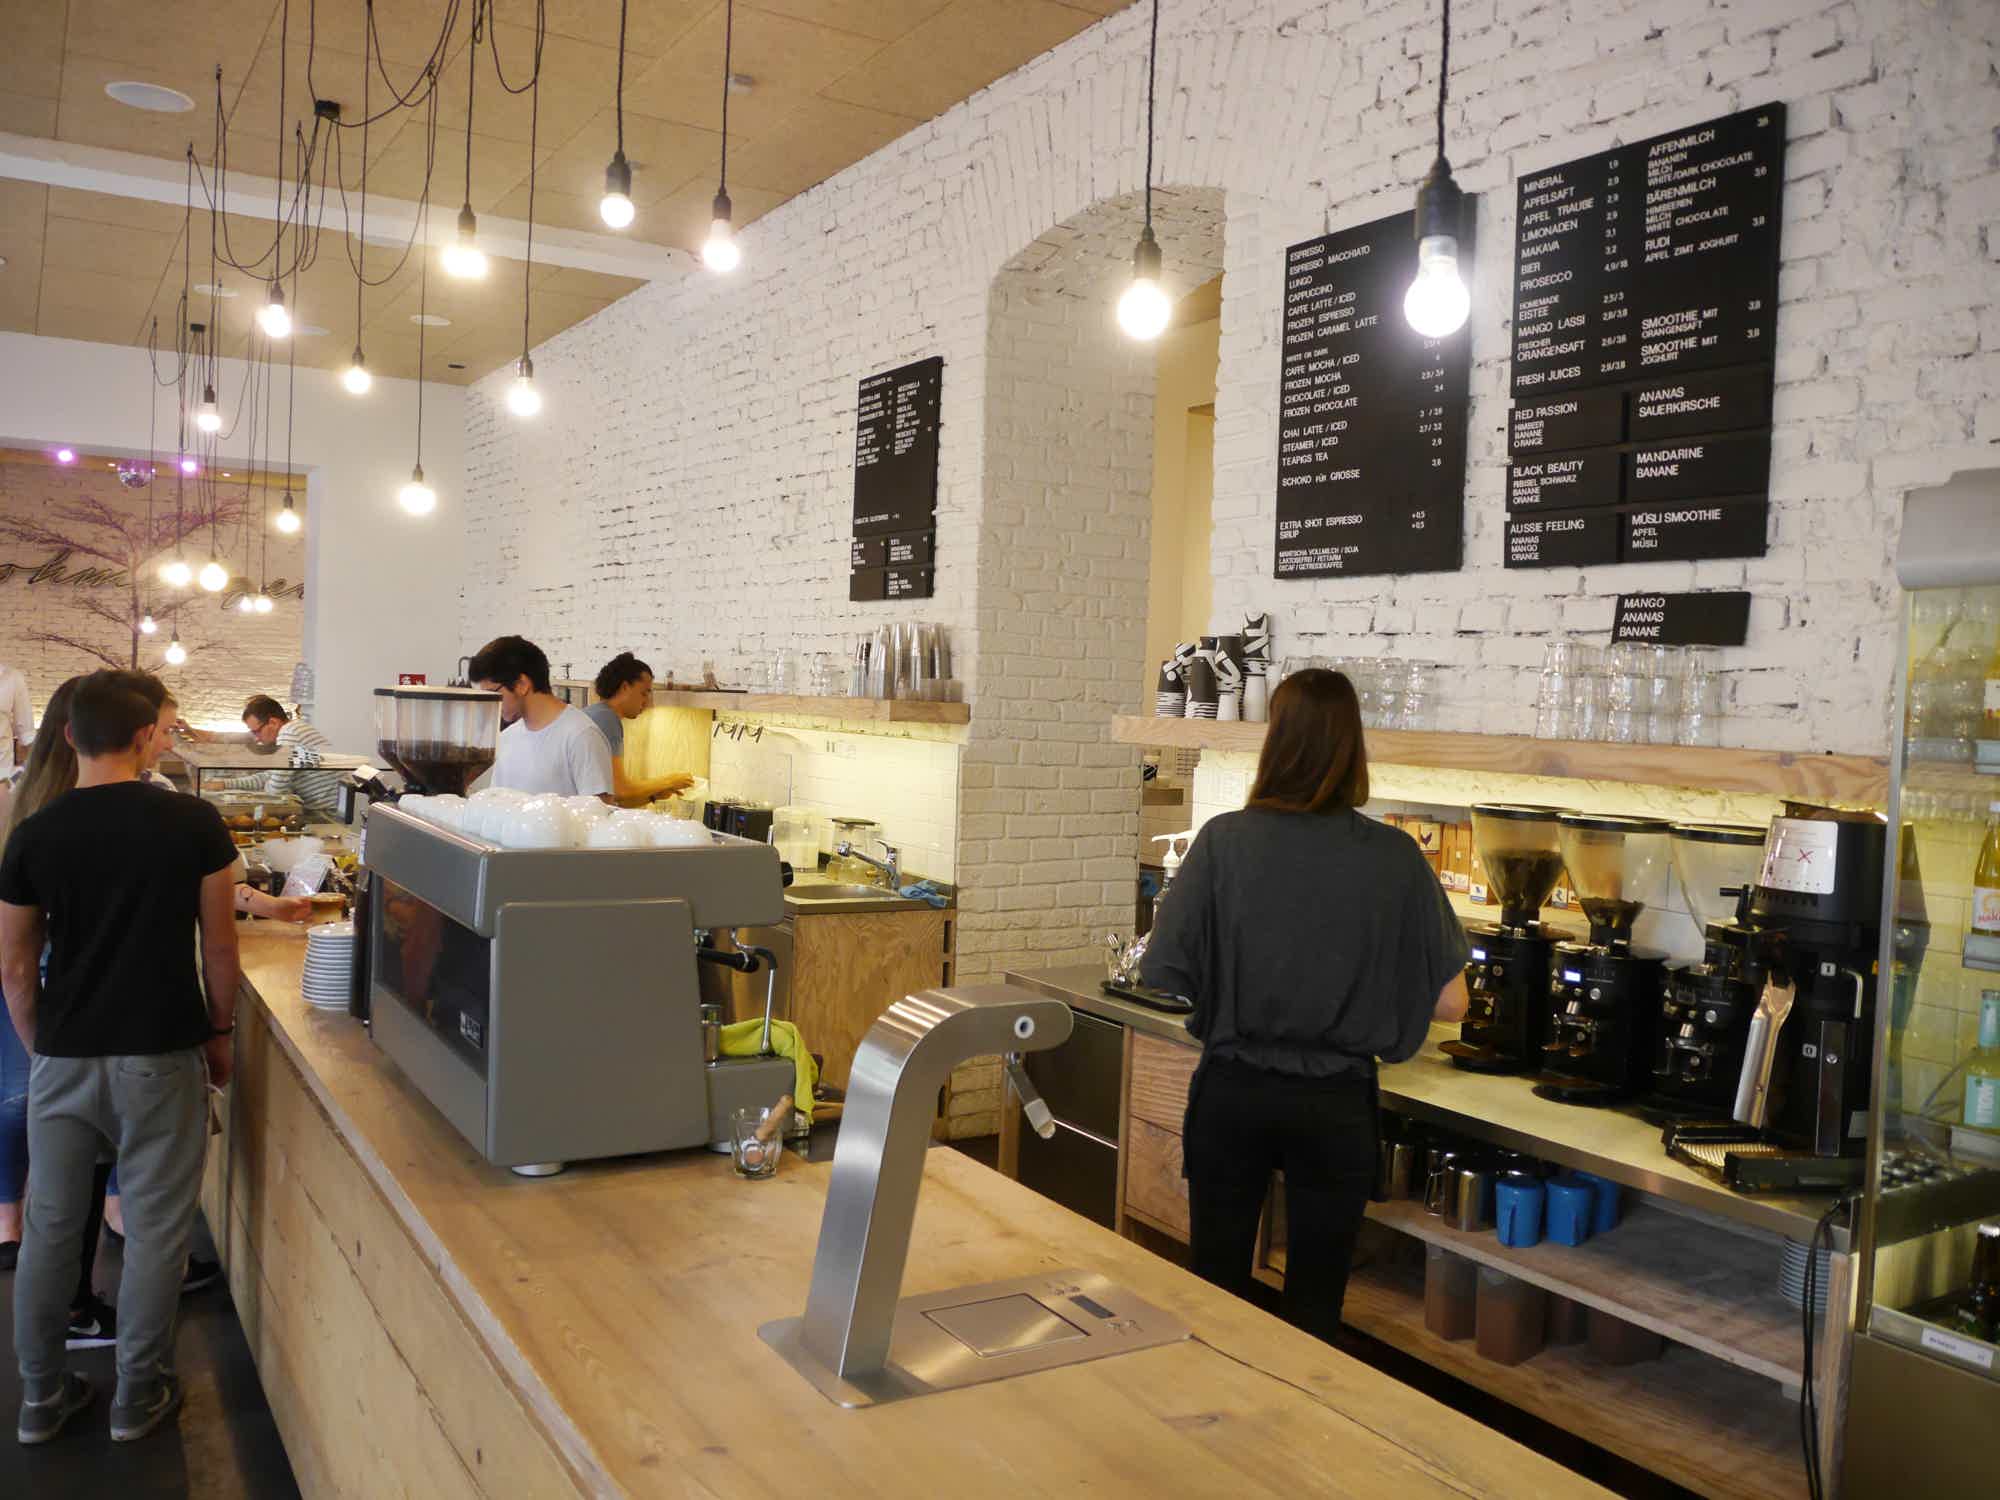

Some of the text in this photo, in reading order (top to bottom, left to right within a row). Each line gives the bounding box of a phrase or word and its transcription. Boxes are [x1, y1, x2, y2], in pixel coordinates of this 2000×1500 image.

[1649, 129, 1715, 158] AFFENMILCH
[1648, 152, 1687, 169] BANANEN
[1700, 151, 1753, 173] CHOCOLATE
[1648, 164, 1673, 177] MILCH
[1523, 172, 1564, 194] MINERAL
[1646, 177, 1717, 205] BÄRENMILCH
[1523, 186, 1575, 210] APFELSAFT
[1523, 197, 1595, 226] APFEL TRAUBE
[1646, 198, 1692, 216] HIMBEEREN
[1646, 212, 1672, 225] MILCH
[1646, 206, 1729, 233] WHITE CHOCOLATE
[1522, 218, 1578, 242] LIMONADEN
[1521, 240, 1560, 259] MAKAVA
[1645, 236, 1671, 251] RUDI
[1645, 233, 1739, 263] APFEL ZIMT JOGHURT
[1289, 245, 1370, 275] ESPRESSO MACCHIATO
[1290, 244, 1325, 261] ESPRESSO
[1521, 262, 1541, 275] BIER
[1289, 275, 1312, 289] LUNGO
[1520, 270, 1573, 292] PROSECCO
[1288, 283, 1333, 303] CAPPUCCINO
[1288, 304, 1309, 317] CAFFE
[1339, 291, 1356, 304] ICED
[1519, 294, 1560, 310] HOMEMADE
[1287, 307, 1355, 331] FROZEN ESPRESSO
[1519, 306, 1550, 321] EISTEE
[1641, 308, 1719, 330] SMOOTHIE MIT
[1287, 315, 1377, 345] FROZEN CARAMEL LATTE
[1518, 314, 1585, 338] MANGO LASSI
[1641, 320, 1703, 339] ORANGENSAFT
[1517, 340, 1586, 362] ORANGENSAFT
[1518, 338, 1551, 351] FRISCHER
[1640, 335, 1719, 357] SMOOTHIE MIT
[1285, 365, 1305, 377] CAFFE
[1308, 359, 1335, 372] MOCHA
[1342, 353, 1360, 365] ICED
[1640, 351, 1679, 366] JOGHURT
[1285, 372, 1342, 390] FROZEN MOCHA
[1517, 366, 1581, 387] FRESH JUICES
[1284, 388, 1326, 404] CHOCOLATE
[1333, 384, 1350, 395] ICED
[1639, 386, 1685, 403] ANANAS
[1284, 397, 1359, 418] FROZEN CHOCOLATE
[1515, 401, 1578, 421] RED PASSION
[1639, 396, 1720, 418] SAUERKIRSCHE
[1283, 428, 1300, 438] CHAI
[1303, 424, 1324, 436] LATTE
[1330, 420, 1348, 431] ICED
[1514, 420, 1545, 431] HIMBEER
[1514, 429, 1543, 440] BANANE
[1514, 437, 1544, 448] ORANGE
[1282, 440, 1314, 453] STEAMER
[1321, 436, 1338, 447] ICED
[1282, 452, 1329, 467] TEAPIGS TEA
[1636, 446, 1704, 464] MANDARINE
[1513, 460, 1584, 478] BLACK BEAUTY
[1636, 464, 1679, 478] BANANE
[1282, 475, 1312, 487] SCHOKO
[1330, 469, 1360, 481] GROSSE
[1540, 474, 1577, 486] SCHWARZ
[1513, 486, 1541, 497] BANANE
[1513, 495, 1541, 505] ORANGE
[1280, 515, 1363, 530] EXTRA SHOT ESPRESSO
[1632, 509, 1721, 526] MÜSLI SMOOTHIE
[1280, 530, 1299, 539] SIRUP
[1510, 519, 1585, 534] AUSSIE FEELING
[1632, 528, 1657, 537] APFEL
[1511, 535, 1539, 545] ANANAS
[1511, 544, 1538, 553] MANGO
[1632, 537, 1657, 548] MÜSLI
[1511, 552, 1540, 561] ORANGE
[1624, 597, 1665, 608] MANGO
[1622, 611, 1664, 622] ANANAS
[1619, 626, 1661, 637] BANANE
